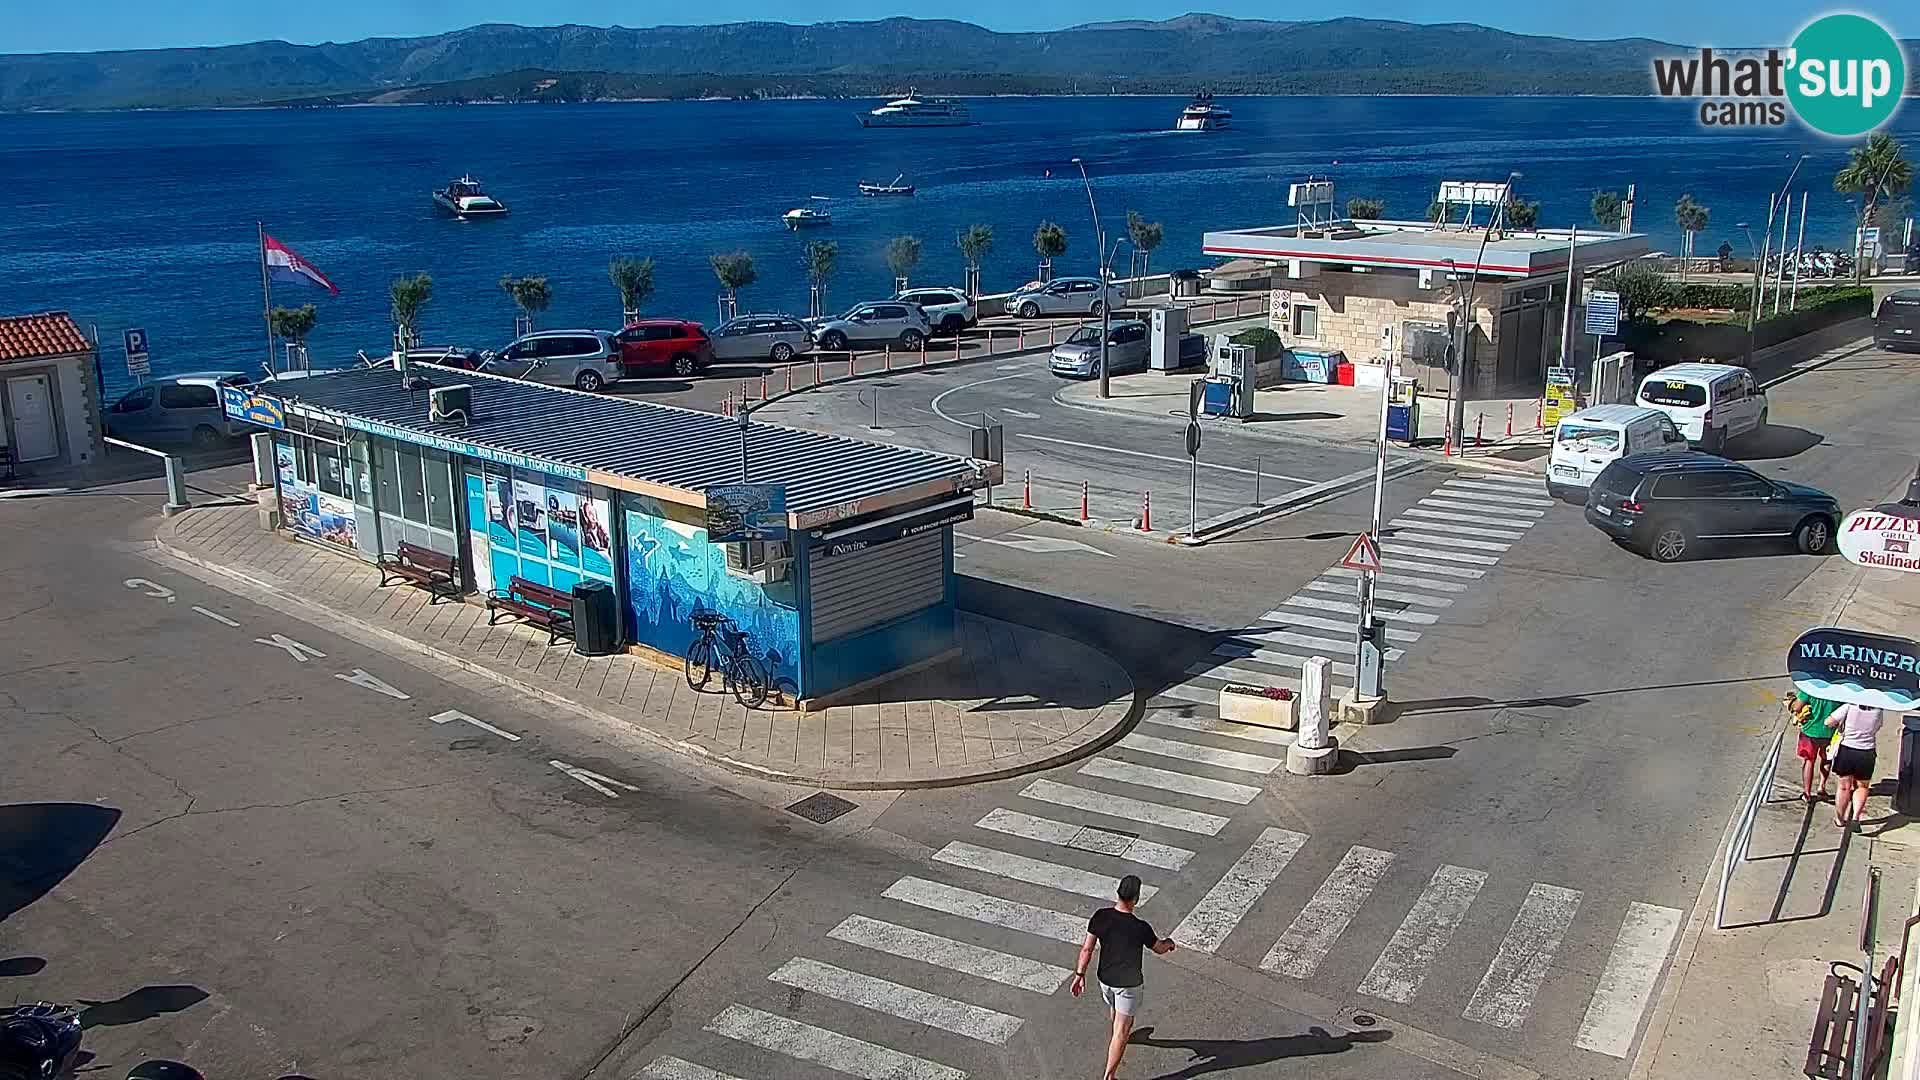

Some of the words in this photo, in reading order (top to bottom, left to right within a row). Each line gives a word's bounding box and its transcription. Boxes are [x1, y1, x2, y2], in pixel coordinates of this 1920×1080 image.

[129, 333, 141, 351] P
[1666, 382, 1685, 390] TAXI
[478, 447, 493, 459] BUS
[494, 451, 526, 467] STATION
[527, 458, 555, 473] TICKET
[555, 464, 582, 479] OFFICE
[1848, 516, 1920, 534] PIZZE
[1881, 531, 1917, 541] GRILL
[1869, 667, 1897, 681] bar
